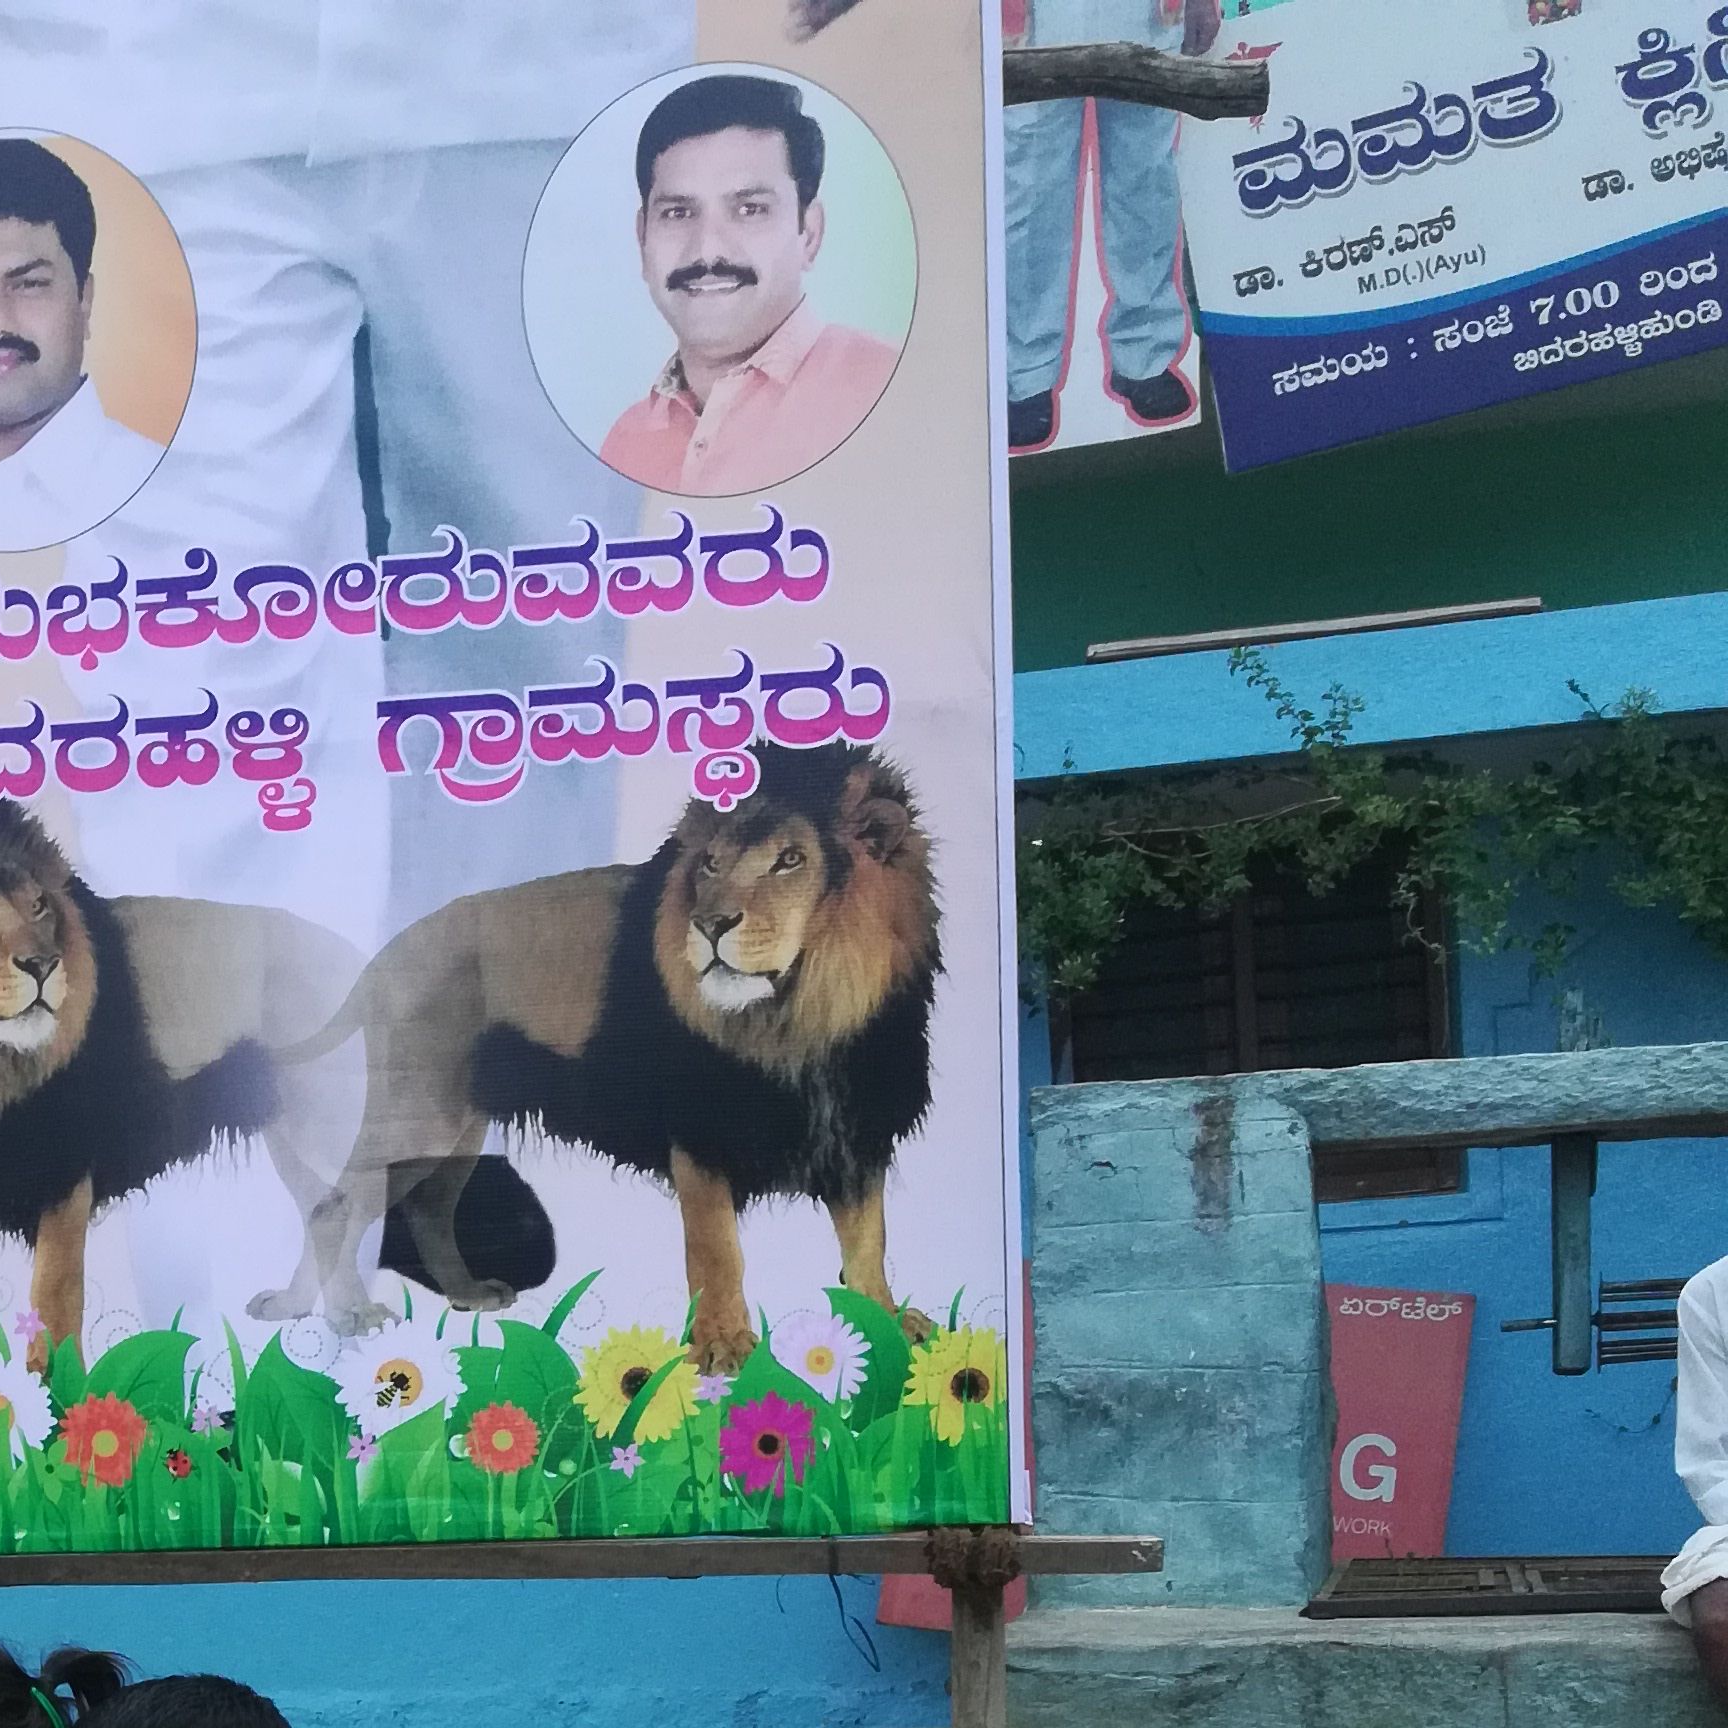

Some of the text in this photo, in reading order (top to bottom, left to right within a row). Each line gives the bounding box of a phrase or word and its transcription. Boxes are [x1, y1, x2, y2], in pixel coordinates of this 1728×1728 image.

[1233, 47, 1563, 217] ಮಮತ
[1233, 265, 1284, 298] ಡಾ.
[1272, 343, 1389, 395] ಸಮಯ
[1433, 305, 1514, 353] ಸಂಜೆ
[1529, 280, 1620, 326] 7.00
[1639, 250, 1719, 297] ರಿಂದ
[376, 643, 890, 813] ಗ್ರಾಮಸ್ಥರು
[1339, 1433, 1397, 1503] G
